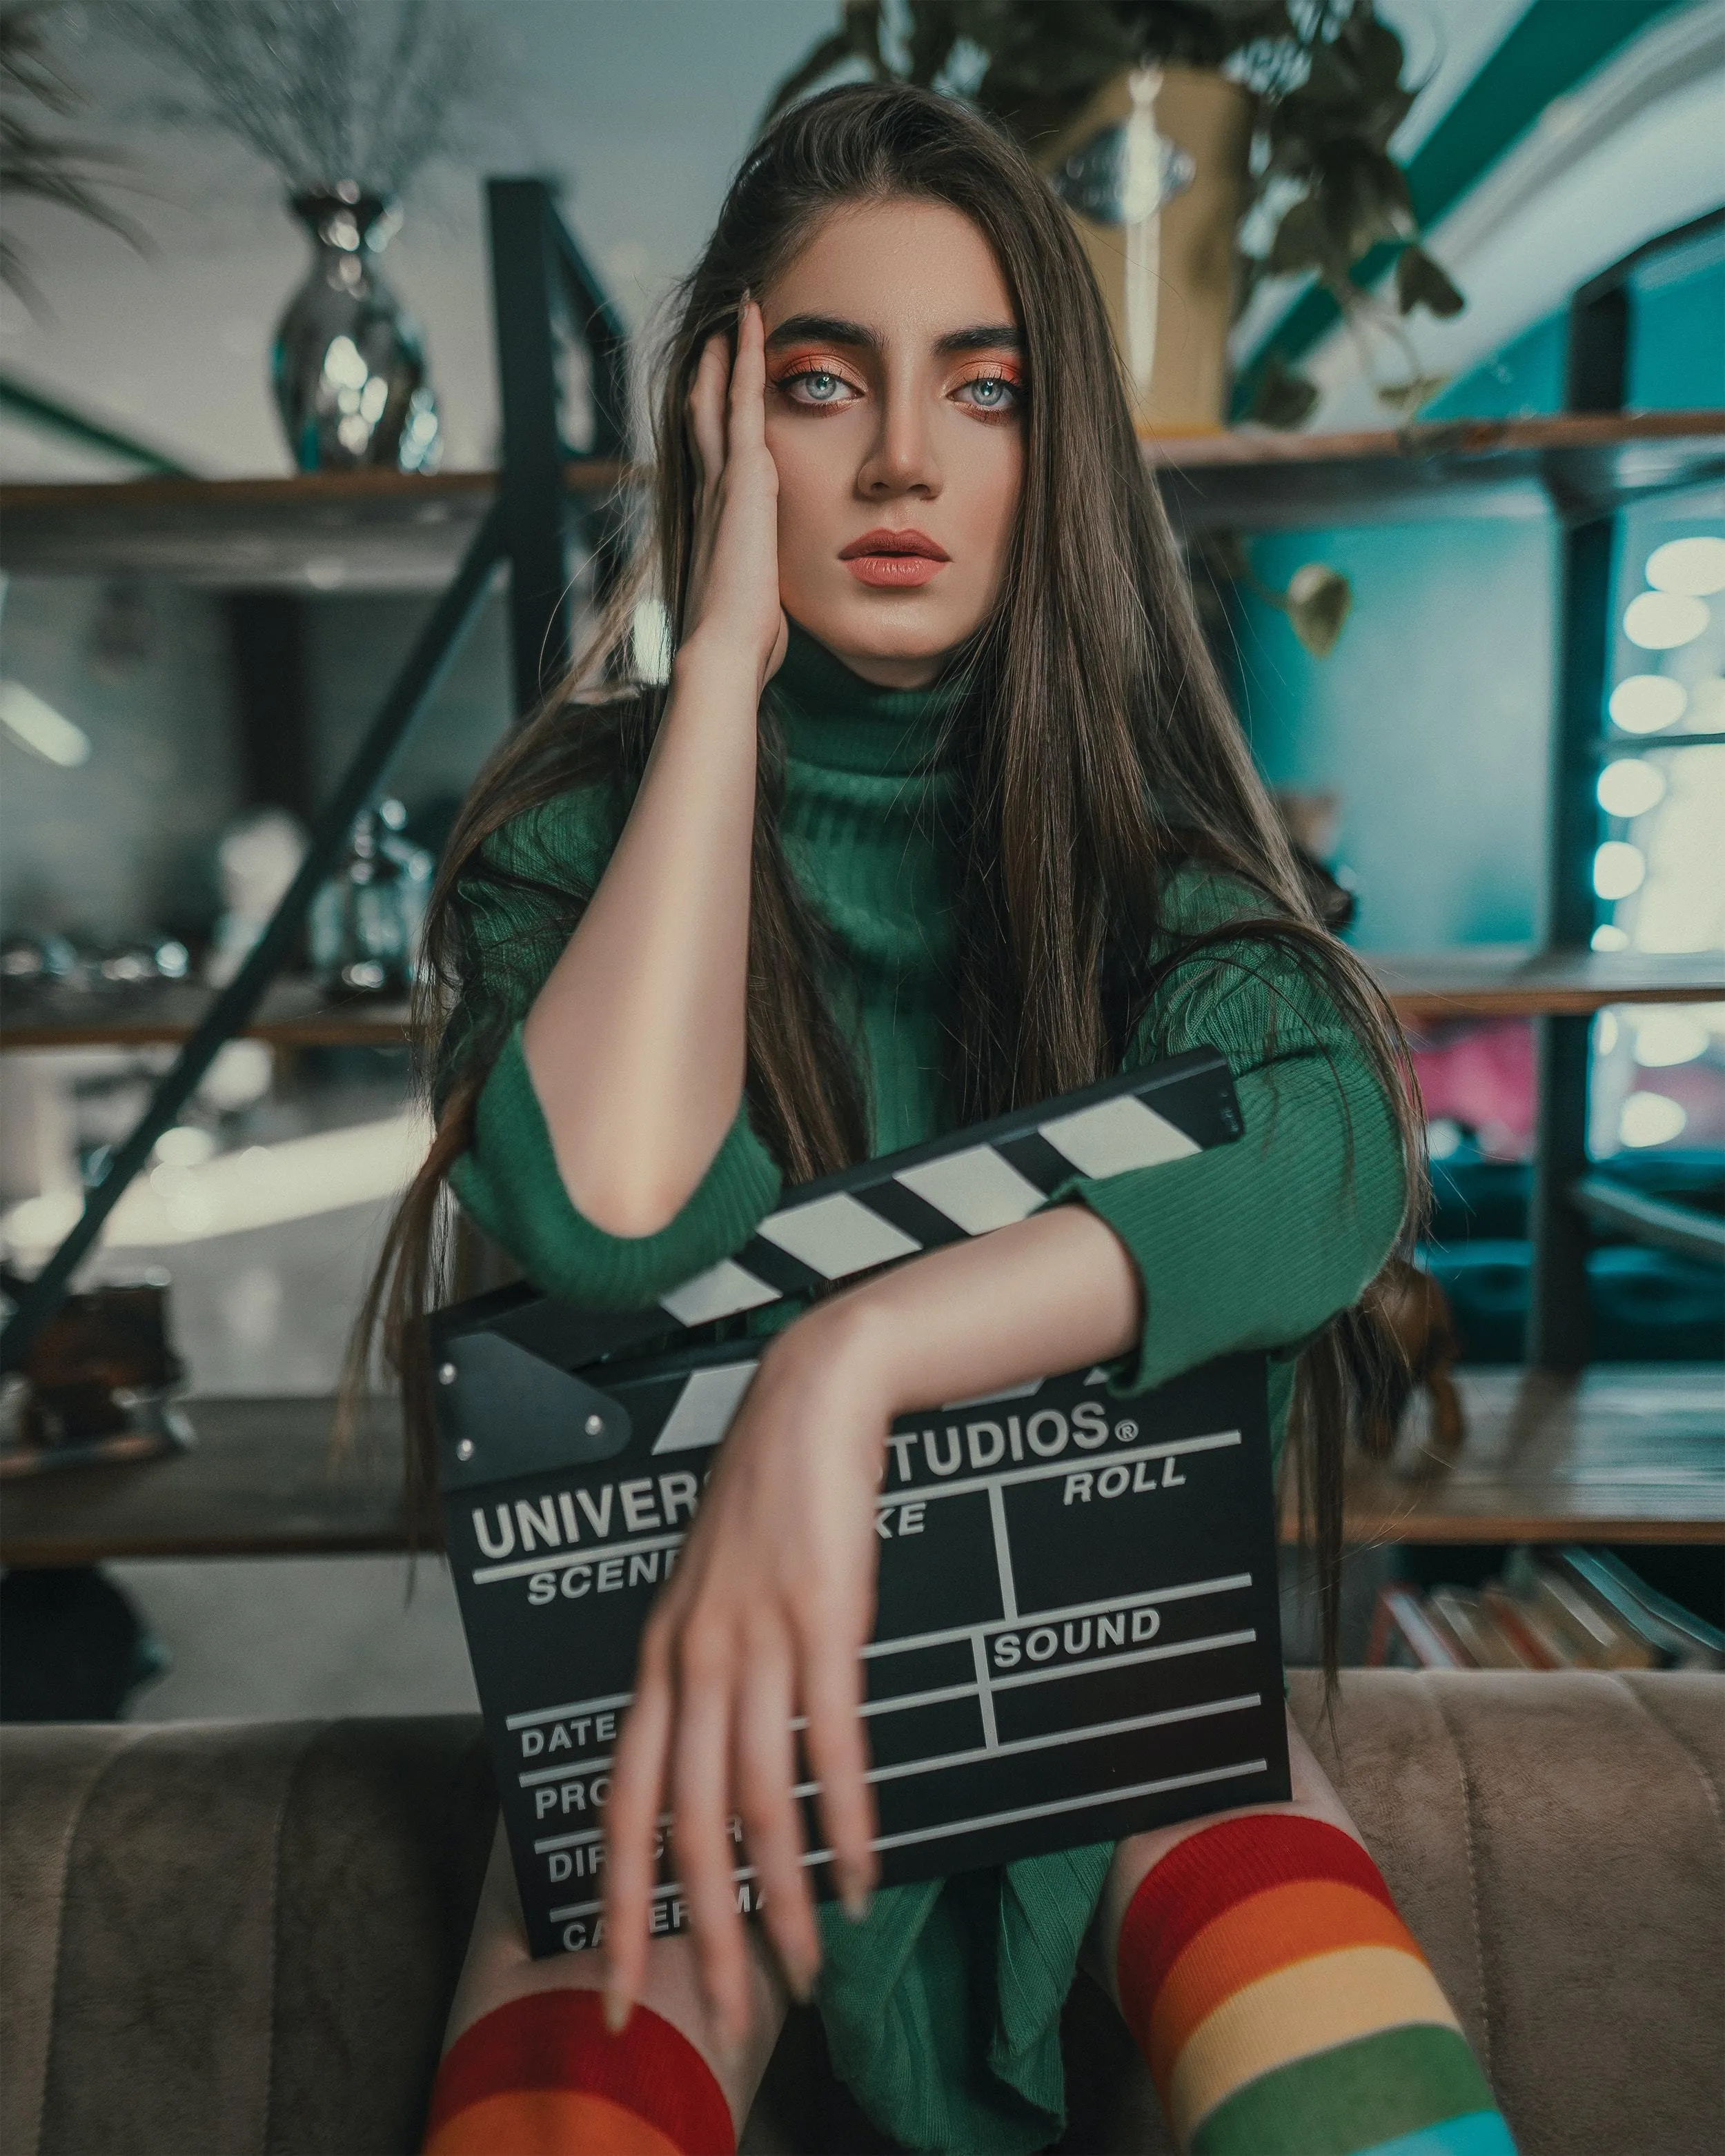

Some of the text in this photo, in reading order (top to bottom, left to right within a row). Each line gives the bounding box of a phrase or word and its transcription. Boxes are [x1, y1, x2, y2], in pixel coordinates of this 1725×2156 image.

[1063, 1456, 1187, 1506] ROLL
[472, 1471, 711, 1559] UNIVER
[994, 1607, 1161, 1668] SOUND
[521, 1712, 617, 1758] DATE
[535, 1777, 613, 1819] PRO
